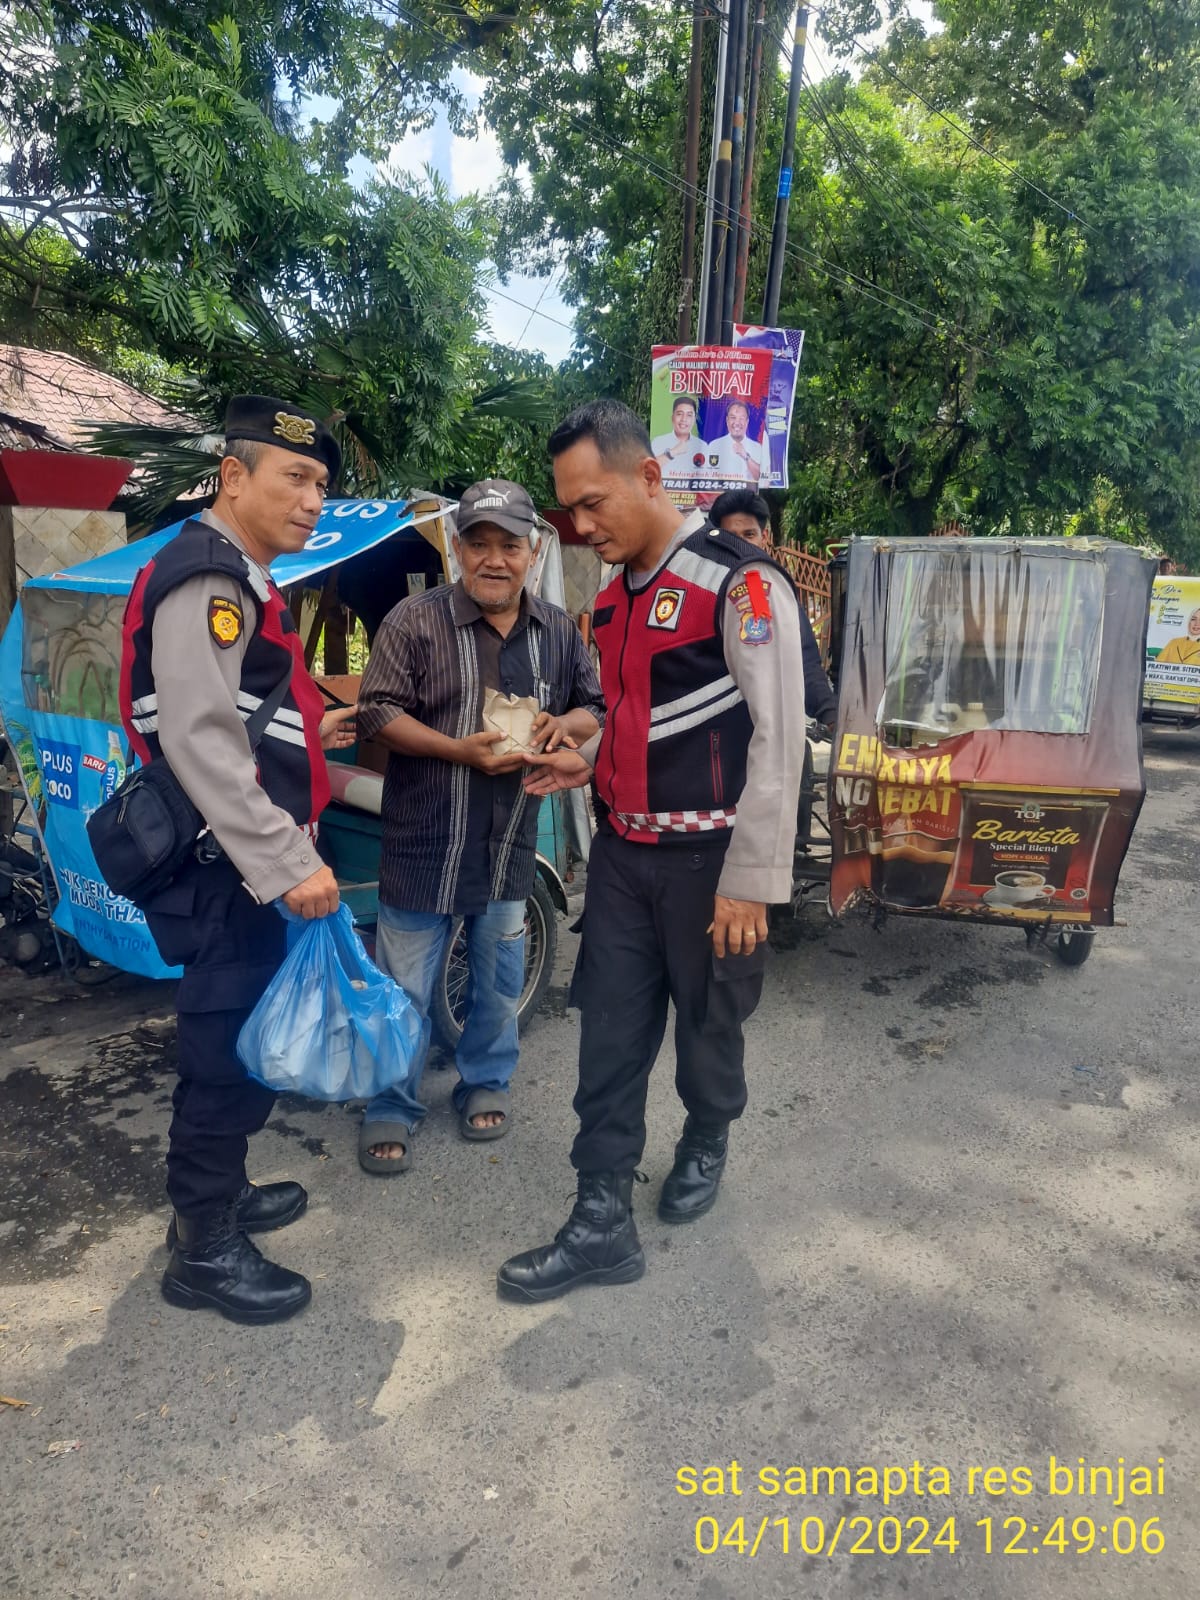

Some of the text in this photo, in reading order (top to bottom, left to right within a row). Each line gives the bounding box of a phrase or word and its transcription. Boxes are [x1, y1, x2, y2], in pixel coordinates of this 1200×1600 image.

[669, 370, 754, 399] BINJAI
[473, 496, 503, 510] PUMA
[39, 749, 73, 774] PLUS
[1014, 810, 1046, 820] TOP
[971, 819, 1081, 845] Barista
[989, 841, 1058, 853] Special Blend
